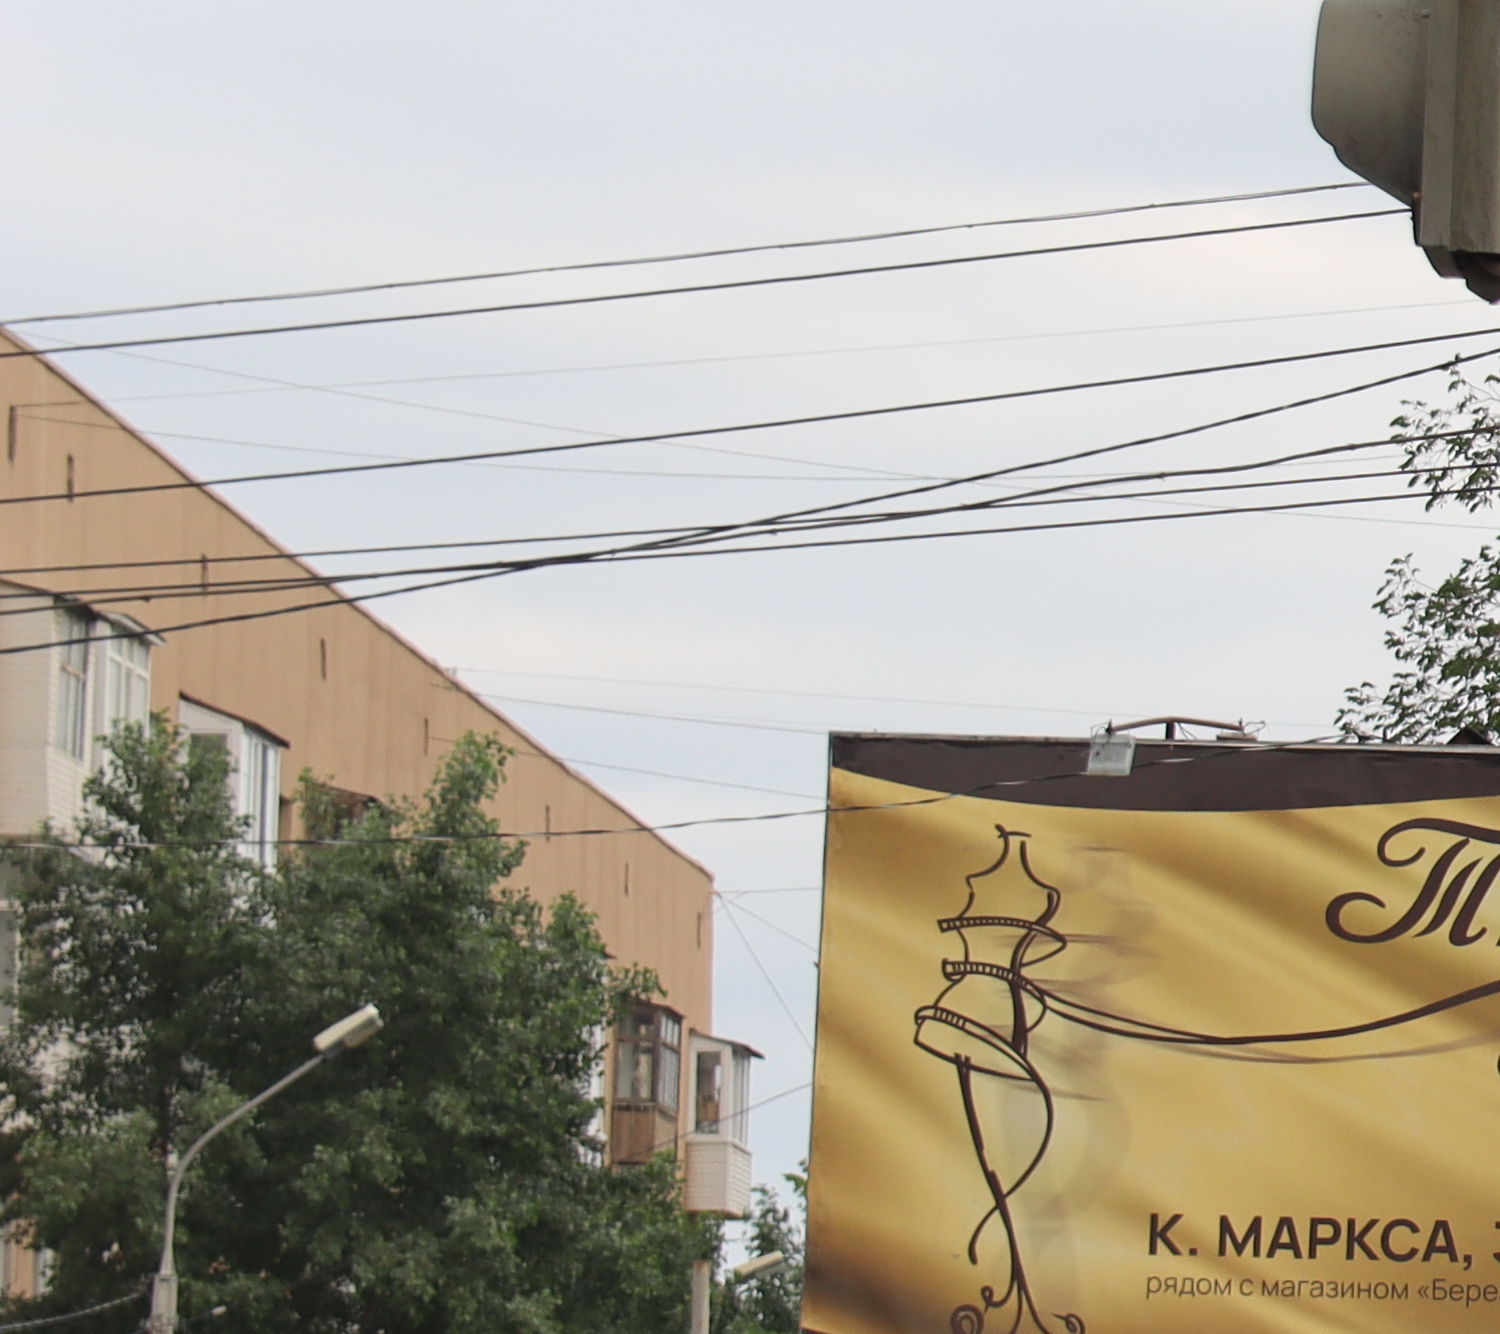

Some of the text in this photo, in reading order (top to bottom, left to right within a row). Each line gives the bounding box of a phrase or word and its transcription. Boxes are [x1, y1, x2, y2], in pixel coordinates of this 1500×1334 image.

[1147, 1212, 1198, 1256] К.
[1217, 1215, 1472, 1271] МАРКСА,
[1146, 1275, 1232, 1300] рядом
[1239, 1278, 1254, 1296] с
[1261, 1278, 1409, 1301] магазином
